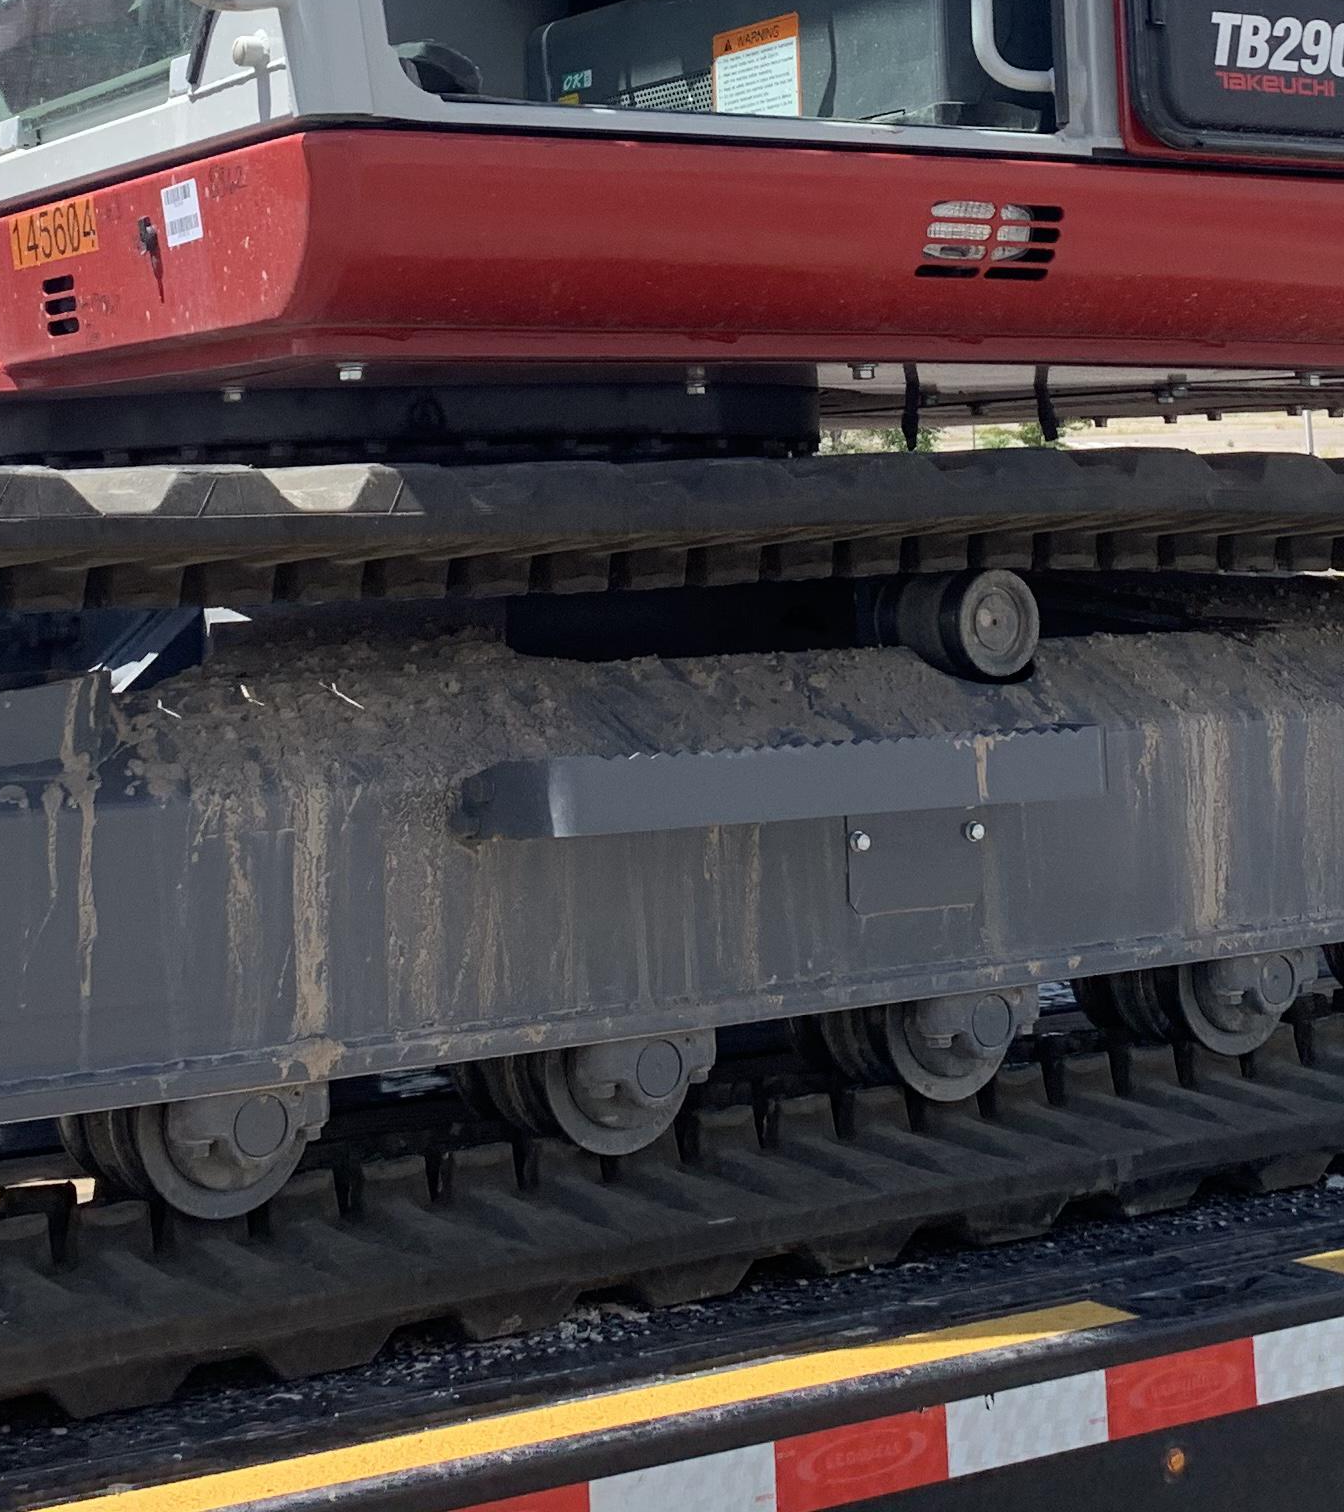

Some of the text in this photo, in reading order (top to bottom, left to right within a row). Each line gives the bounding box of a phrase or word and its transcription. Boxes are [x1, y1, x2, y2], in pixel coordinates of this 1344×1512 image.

[737, 24, 780, 47] WARNING
[562, 72, 585, 91] OK
[1215, 71, 1336, 97] TAKEUCHI
[12, 199, 96, 265] 145604
